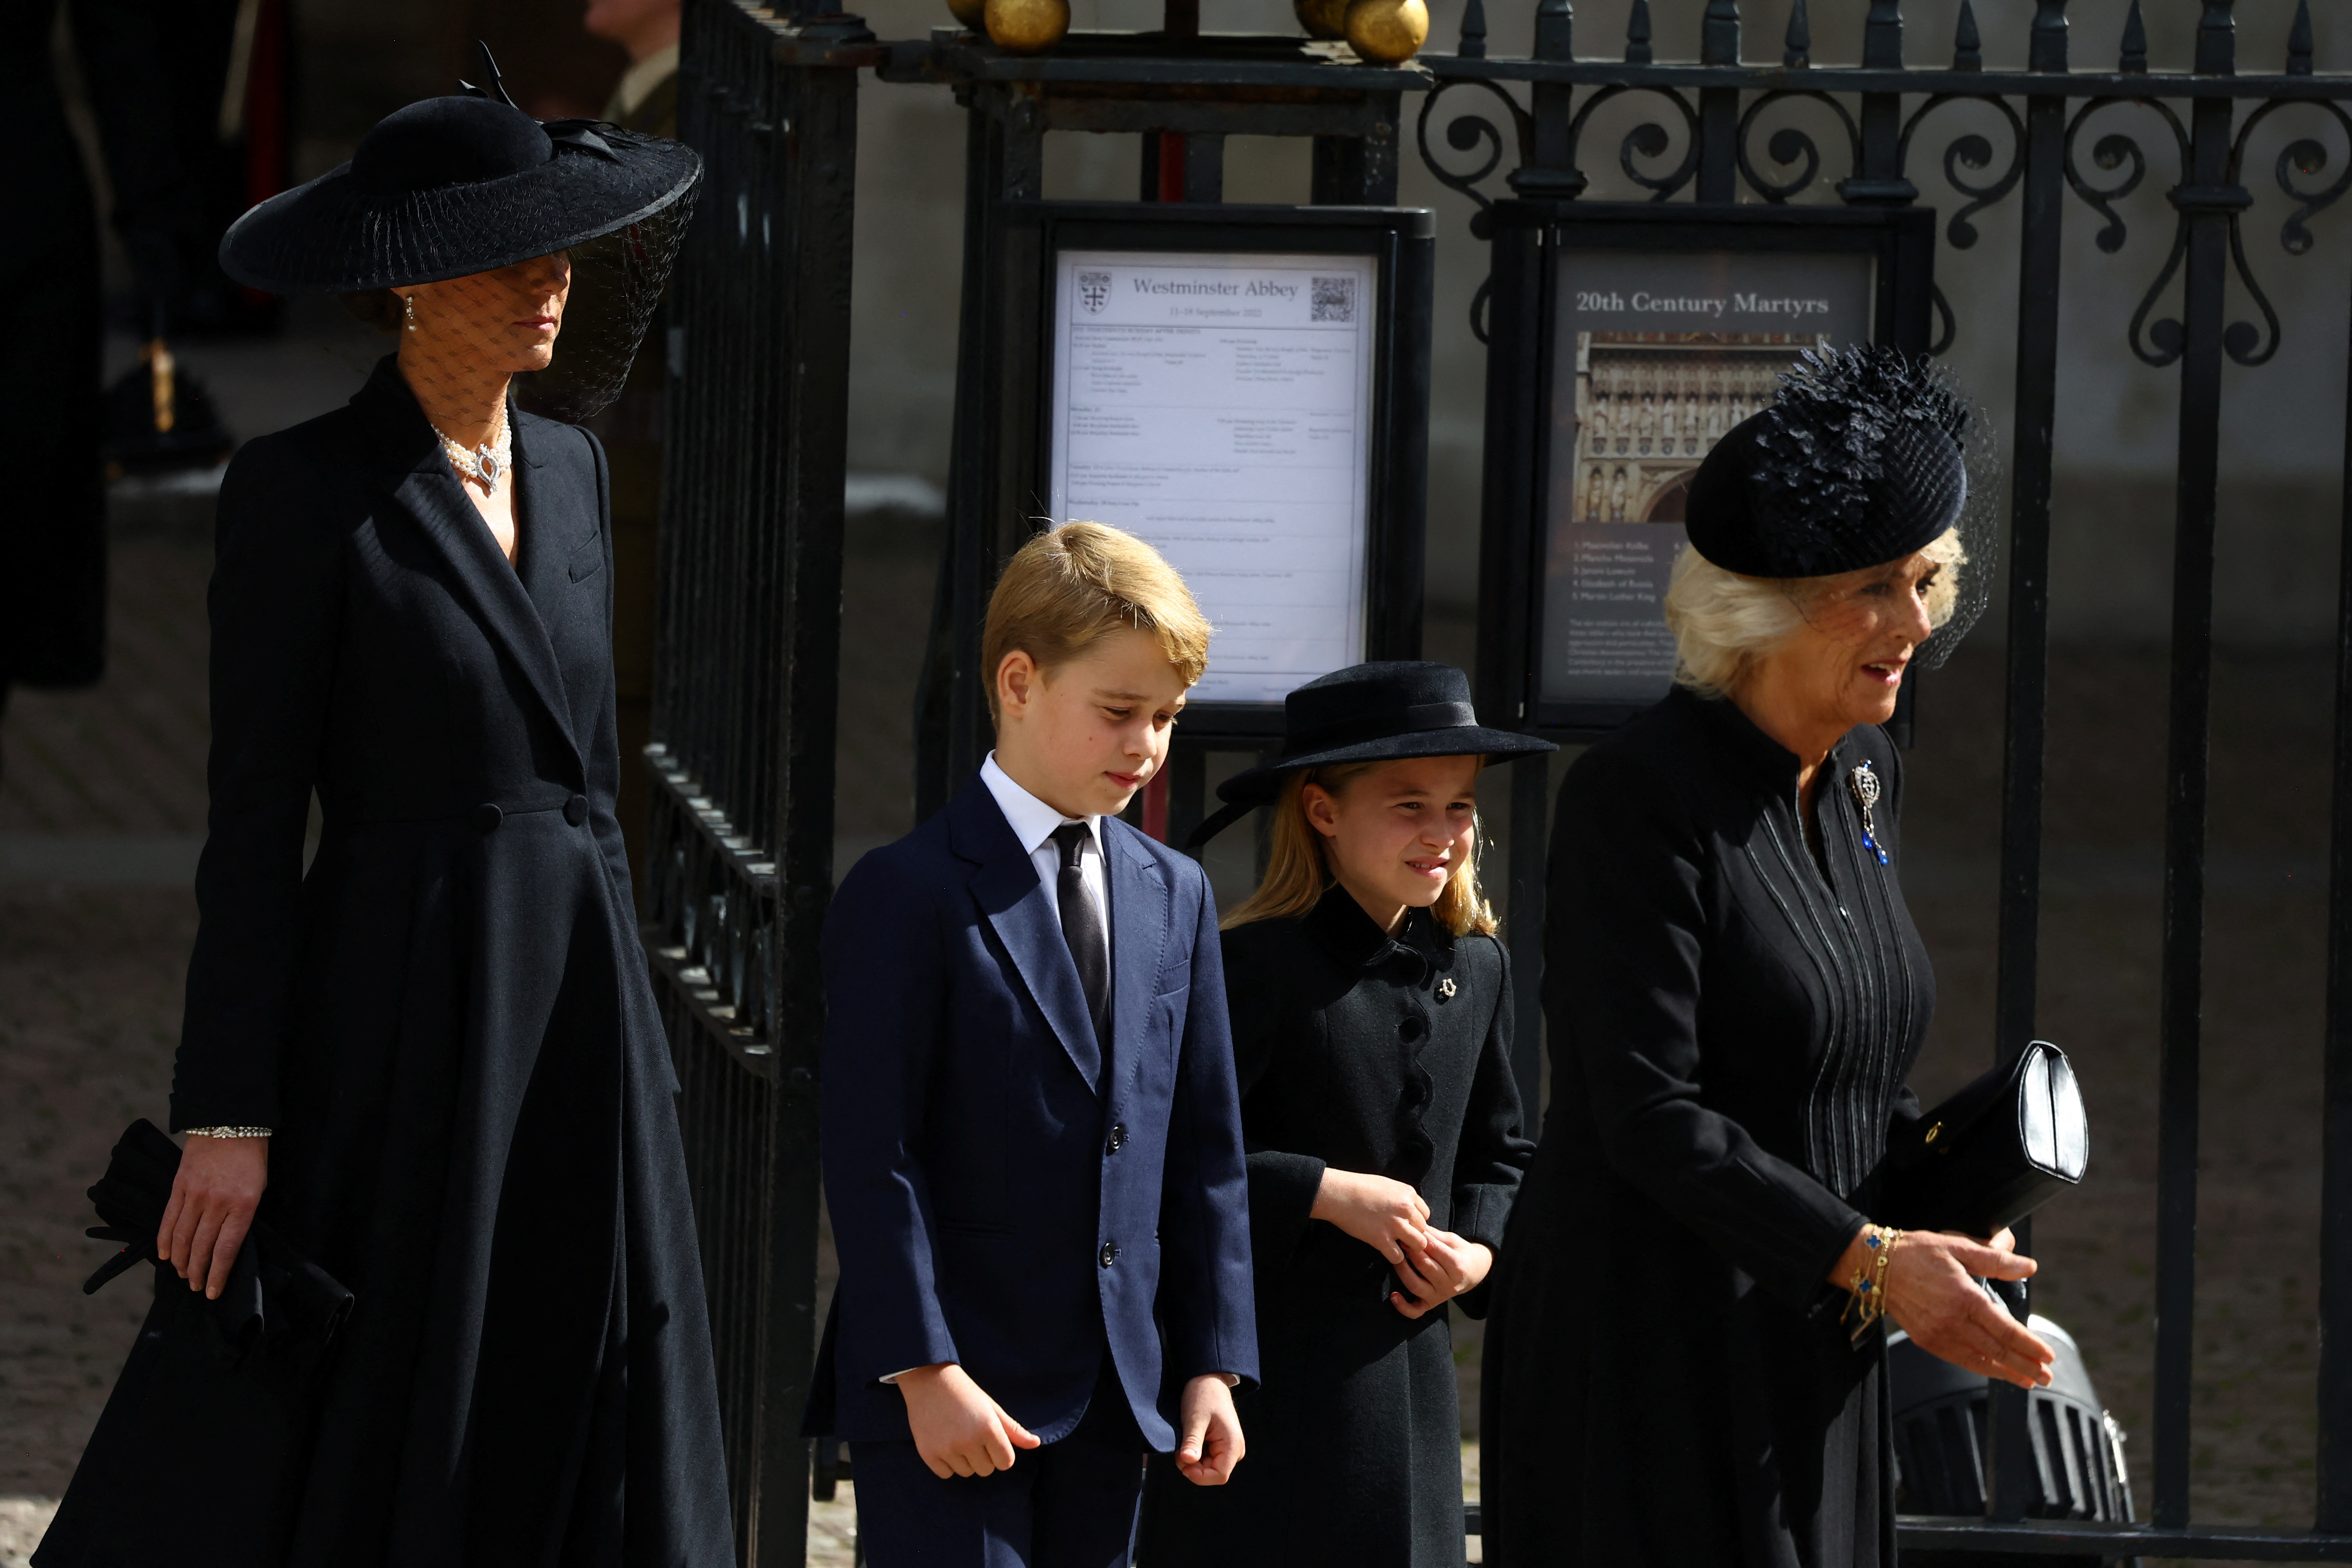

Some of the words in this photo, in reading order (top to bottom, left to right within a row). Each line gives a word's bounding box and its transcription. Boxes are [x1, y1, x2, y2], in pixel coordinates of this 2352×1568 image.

[1134, 278, 1239, 295] Westminster
[1245, 280, 1299, 301] Abbey
[1196, 307, 1240, 318] September
[1576, 292, 1624, 311] 20th
[1631, 292, 1725, 318] Century
[1734, 292, 1829, 319] Martyrs
